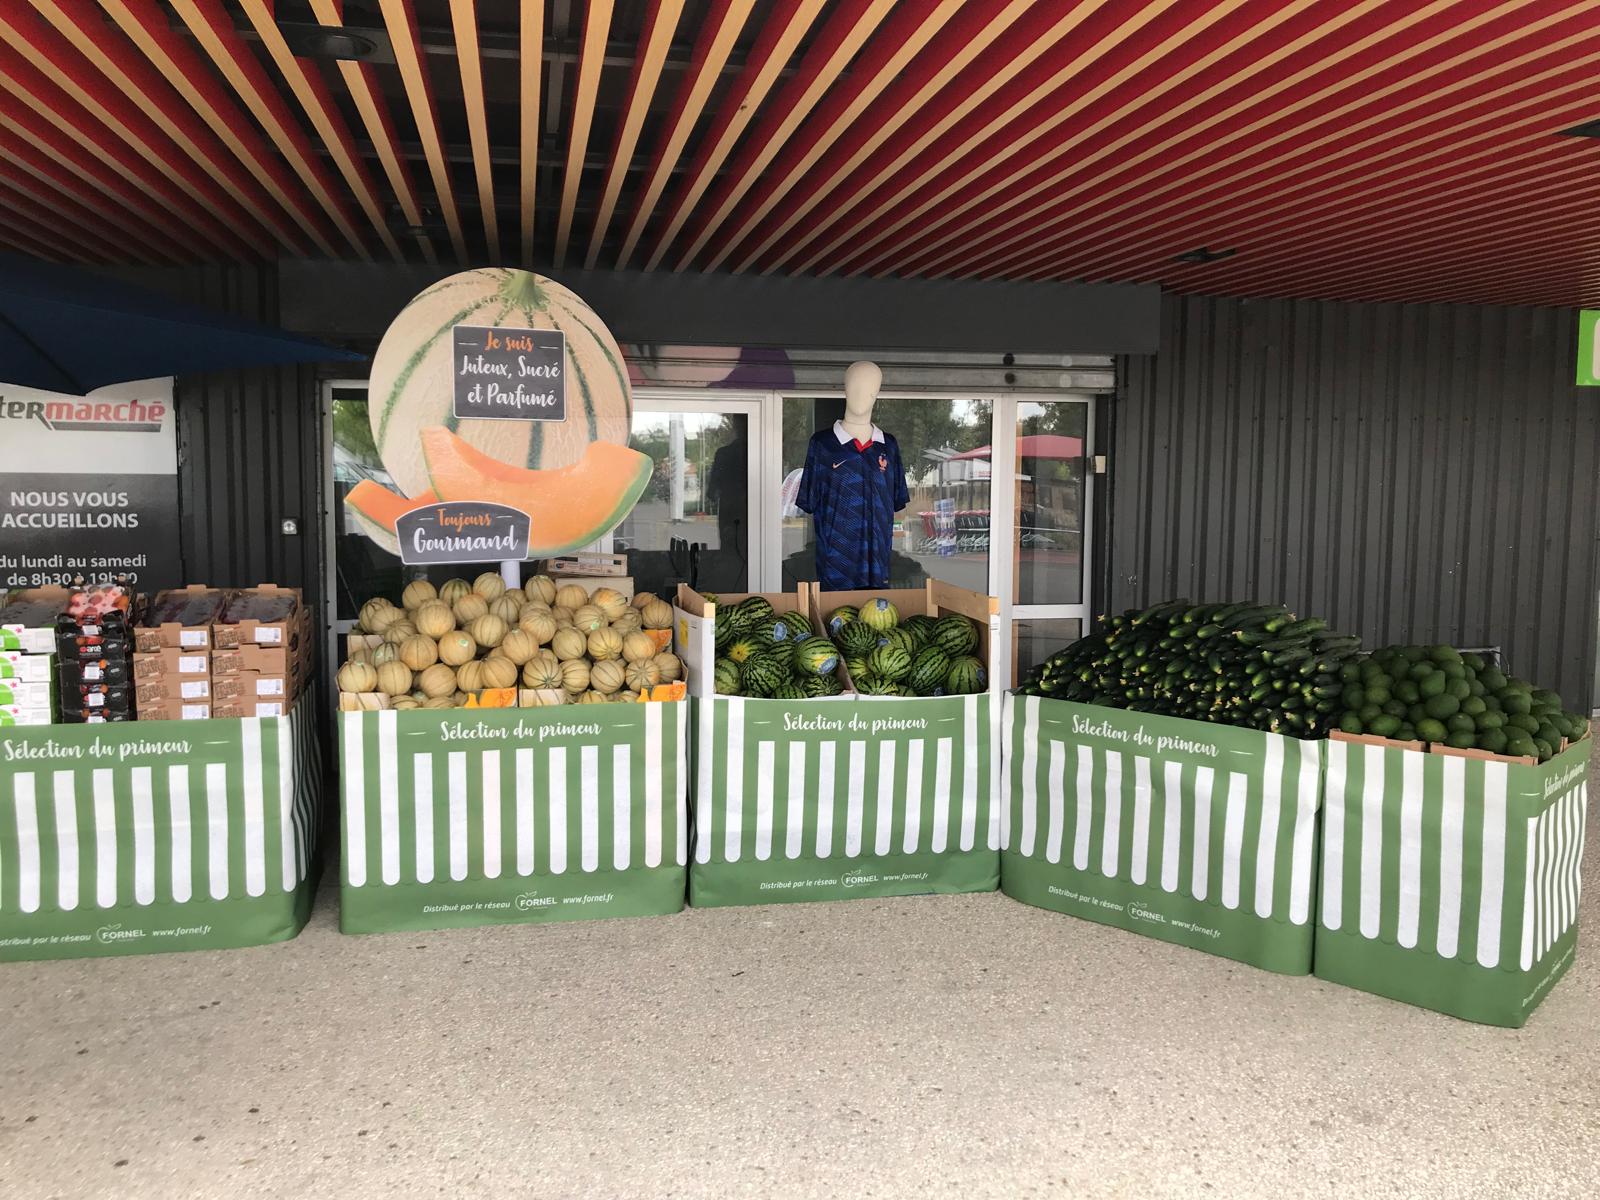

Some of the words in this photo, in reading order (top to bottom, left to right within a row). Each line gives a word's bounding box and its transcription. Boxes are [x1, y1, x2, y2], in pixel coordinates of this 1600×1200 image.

[484, 330, 501, 351] Je
[505, 335, 535, 353] suis
[459, 355, 513, 379] Juteux,
[517, 355, 561, 378] Sucré
[467, 383, 484, 404] et
[487, 382, 557, 409] Parfumé
[10, 492, 68, 507] NOUS
[72, 492, 129, 507] VOUS
[1, 512, 139, 529] ACCUEILLONS
[436, 508, 493, 533] Toujours
[413, 525, 519, 554] Gourmand
[0, 554, 17, 568] du
[21, 554, 63, 568] lundi
[66, 557, 87, 568] au
[90, 554, 147, 567] samedi
[7, 572, 28, 586] de
[31, 572, 72, 586] 8h30
[440, 720, 509, 742] Sélection
[513, 718, 536, 739] du
[539, 722, 602, 742] primeur
[784, 711, 845, 732] Sélection
[848, 712, 869, 731] du
[872, 716, 928, 736] primeur
[1072, 714, 1130, 743] Sélection
[1133, 725, 1155, 746] du
[1156, 734, 1220, 758] primeur
[3, 738, 85, 762] Sélection
[88, 736, 115, 758] du
[119, 739, 192, 762] primeur
[760, 880, 792, 890] Distribué
[792, 880, 806, 889] par
[813, 878, 838, 887] réseau
[845, 874, 879, 885] FORNEL
[883, 872, 929, 882] www.fornel.fr
[520, 897, 558, 908] FORNEL
[562, 893, 614, 904] www.fornel.fr
[423, 904, 459, 913] Distribué
[459, 903, 474, 913] par
[484, 900, 511, 910] réseau
[1131, 907, 1168, 923] FORNEL
[102, 929, 147, 940] FORNEL
[152, 925, 213, 937] www.fornel.fr
[33, 936, 49, 947] par
[60, 933, 92, 943] réseau
